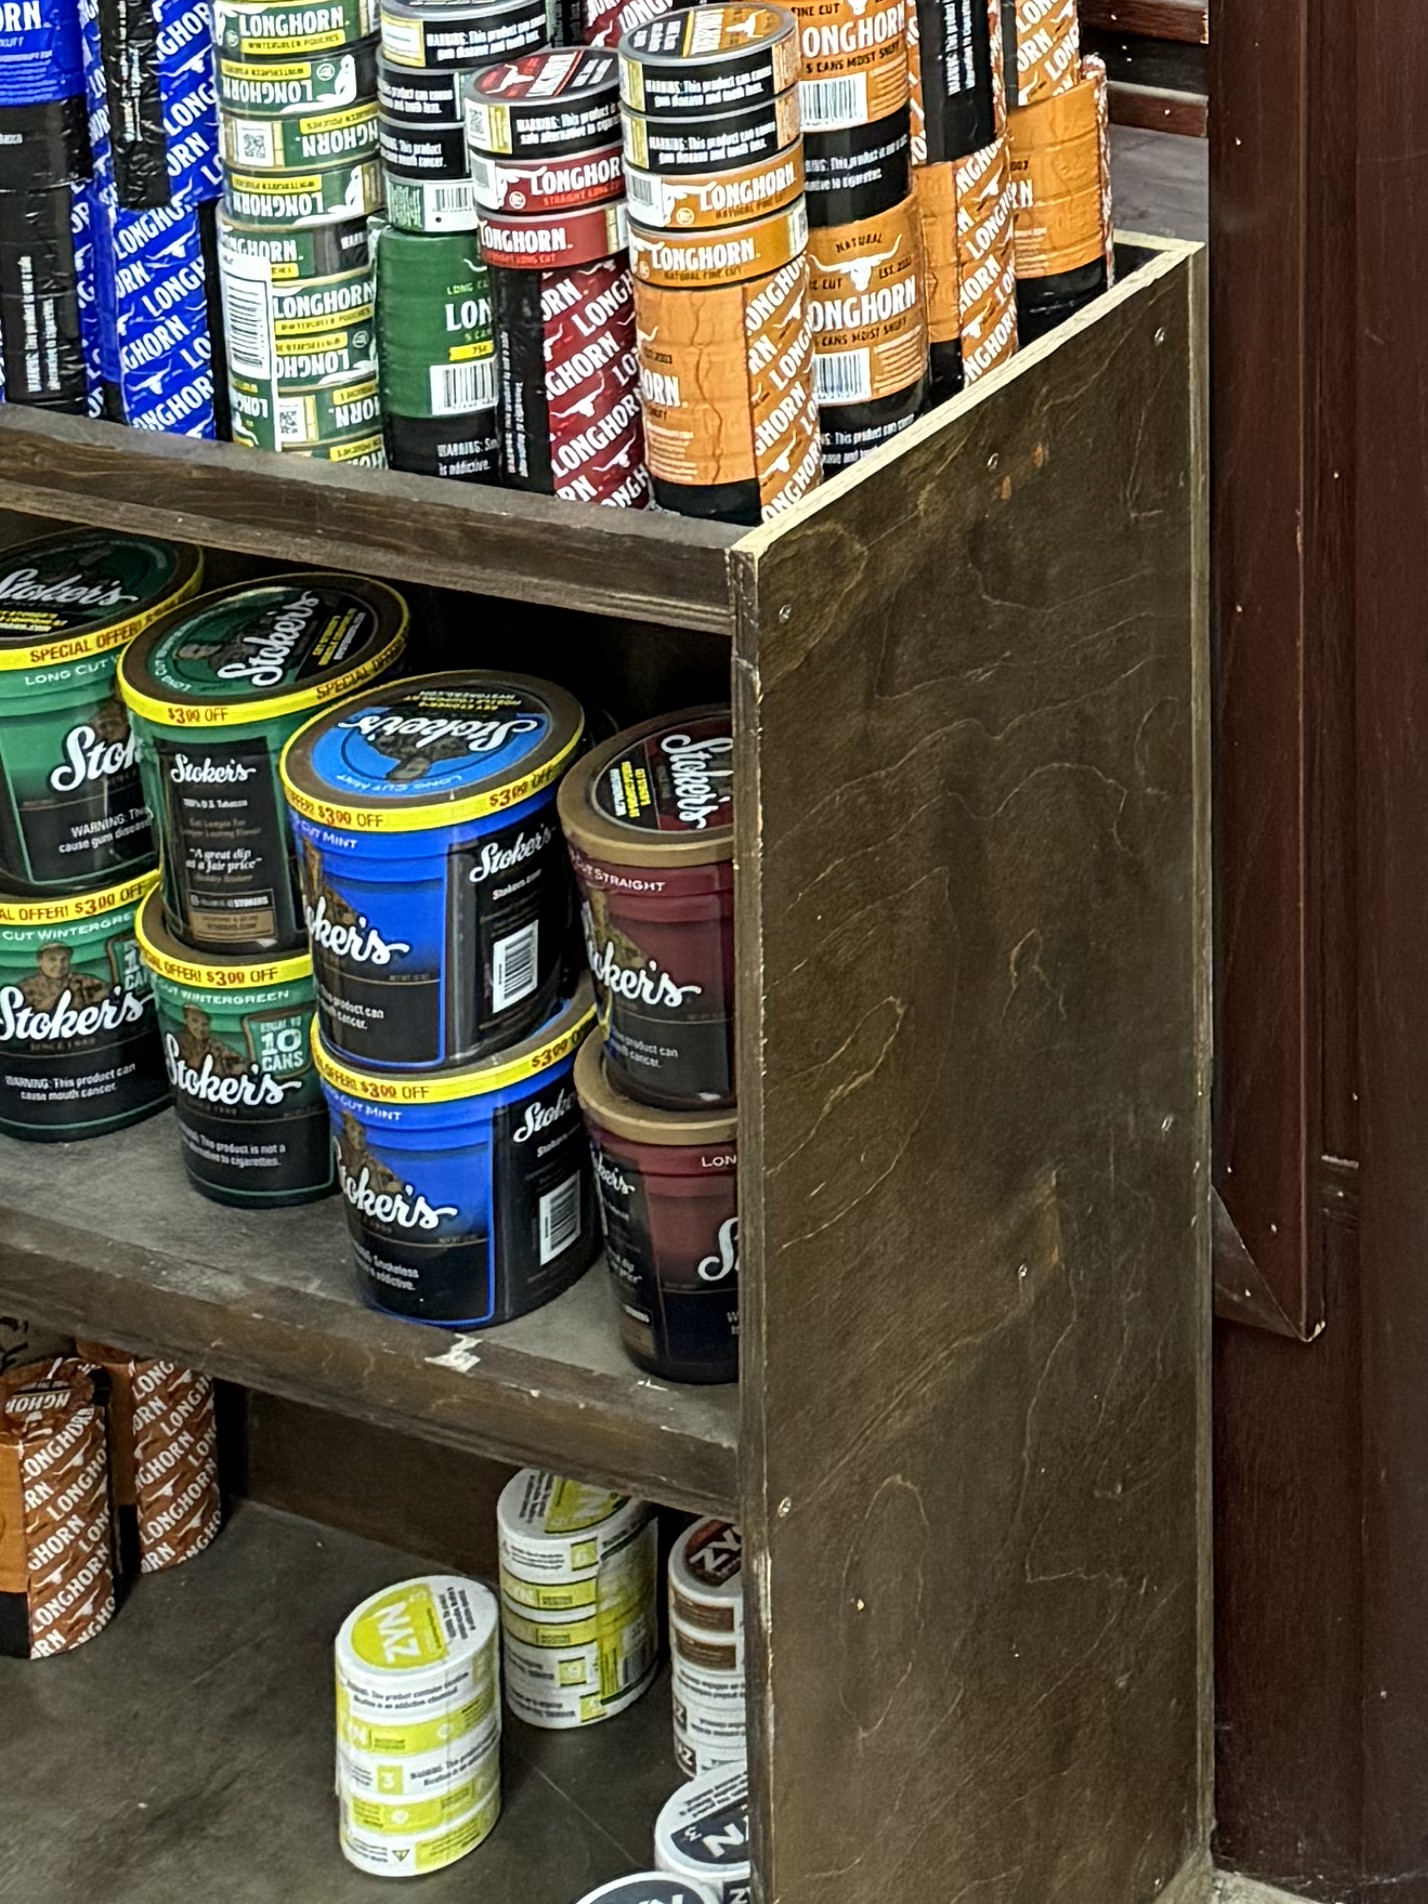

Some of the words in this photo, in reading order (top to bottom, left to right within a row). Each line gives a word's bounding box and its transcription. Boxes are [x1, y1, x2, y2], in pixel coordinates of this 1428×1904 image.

[239, 6, 344, 37] LONGHORN
[819, 3, 840, 16] CUT
[817, 58, 844, 73] CANS
[847, 50, 875, 69] MOIST
[222, 78, 313, 104] LONGHORN
[530, 154, 621, 196] LONGHOR
[701, 162, 796, 213] LONGHORN
[232, 192, 324, 217] LONGHORN
[481, 221, 566, 253] LONGHORN
[836, 232, 883, 253] NATURAL
[650, 238, 755, 271] LONGHORN
[822, 332, 848, 348] CANS
[851, 326, 881, 343] MOIST
[0, 568, 138, 605] Stoker's
[218, 590, 320, 687] Stoker's
[30, 639, 93, 663] SPECIAL
[25, 669, 72, 686] LONG
[75, 662, 107, 678] CUT
[204, 707, 230, 723] OFF
[337, 714, 539, 752] Stoker's
[170, 753, 257, 783] Stoker's
[71, 813, 127, 838] WARNING:
[357, 815, 384, 828] OFF
[59, 837, 90, 854] cause
[92, 832, 113, 850] gum
[322, 832, 359, 850] MINT
[120, 882, 146, 902] OFF
[594, 868, 666, 893] STRAIGHT
[2, 930, 35, 942] CUT
[250, 967, 279, 983] OFF
[180, 989, 290, 1006] WINTERGREEN
[0, 985, 155, 1041] Stoker's
[365, 1005, 384, 1020] can
[261, 1028, 301, 1057] 10
[165, 1033, 303, 1106] Stoker's
[261, 1051, 304, 1073] CANS
[53, 1075, 75, 1090] This
[76, 1068, 116, 1087] product
[117, 1062, 137, 1079] can
[49, 1087, 79, 1100] mouth
[402, 1085, 430, 1100] OFF
[366, 1104, 402, 1121] MINT
[261, 1143, 277, 1155] not
